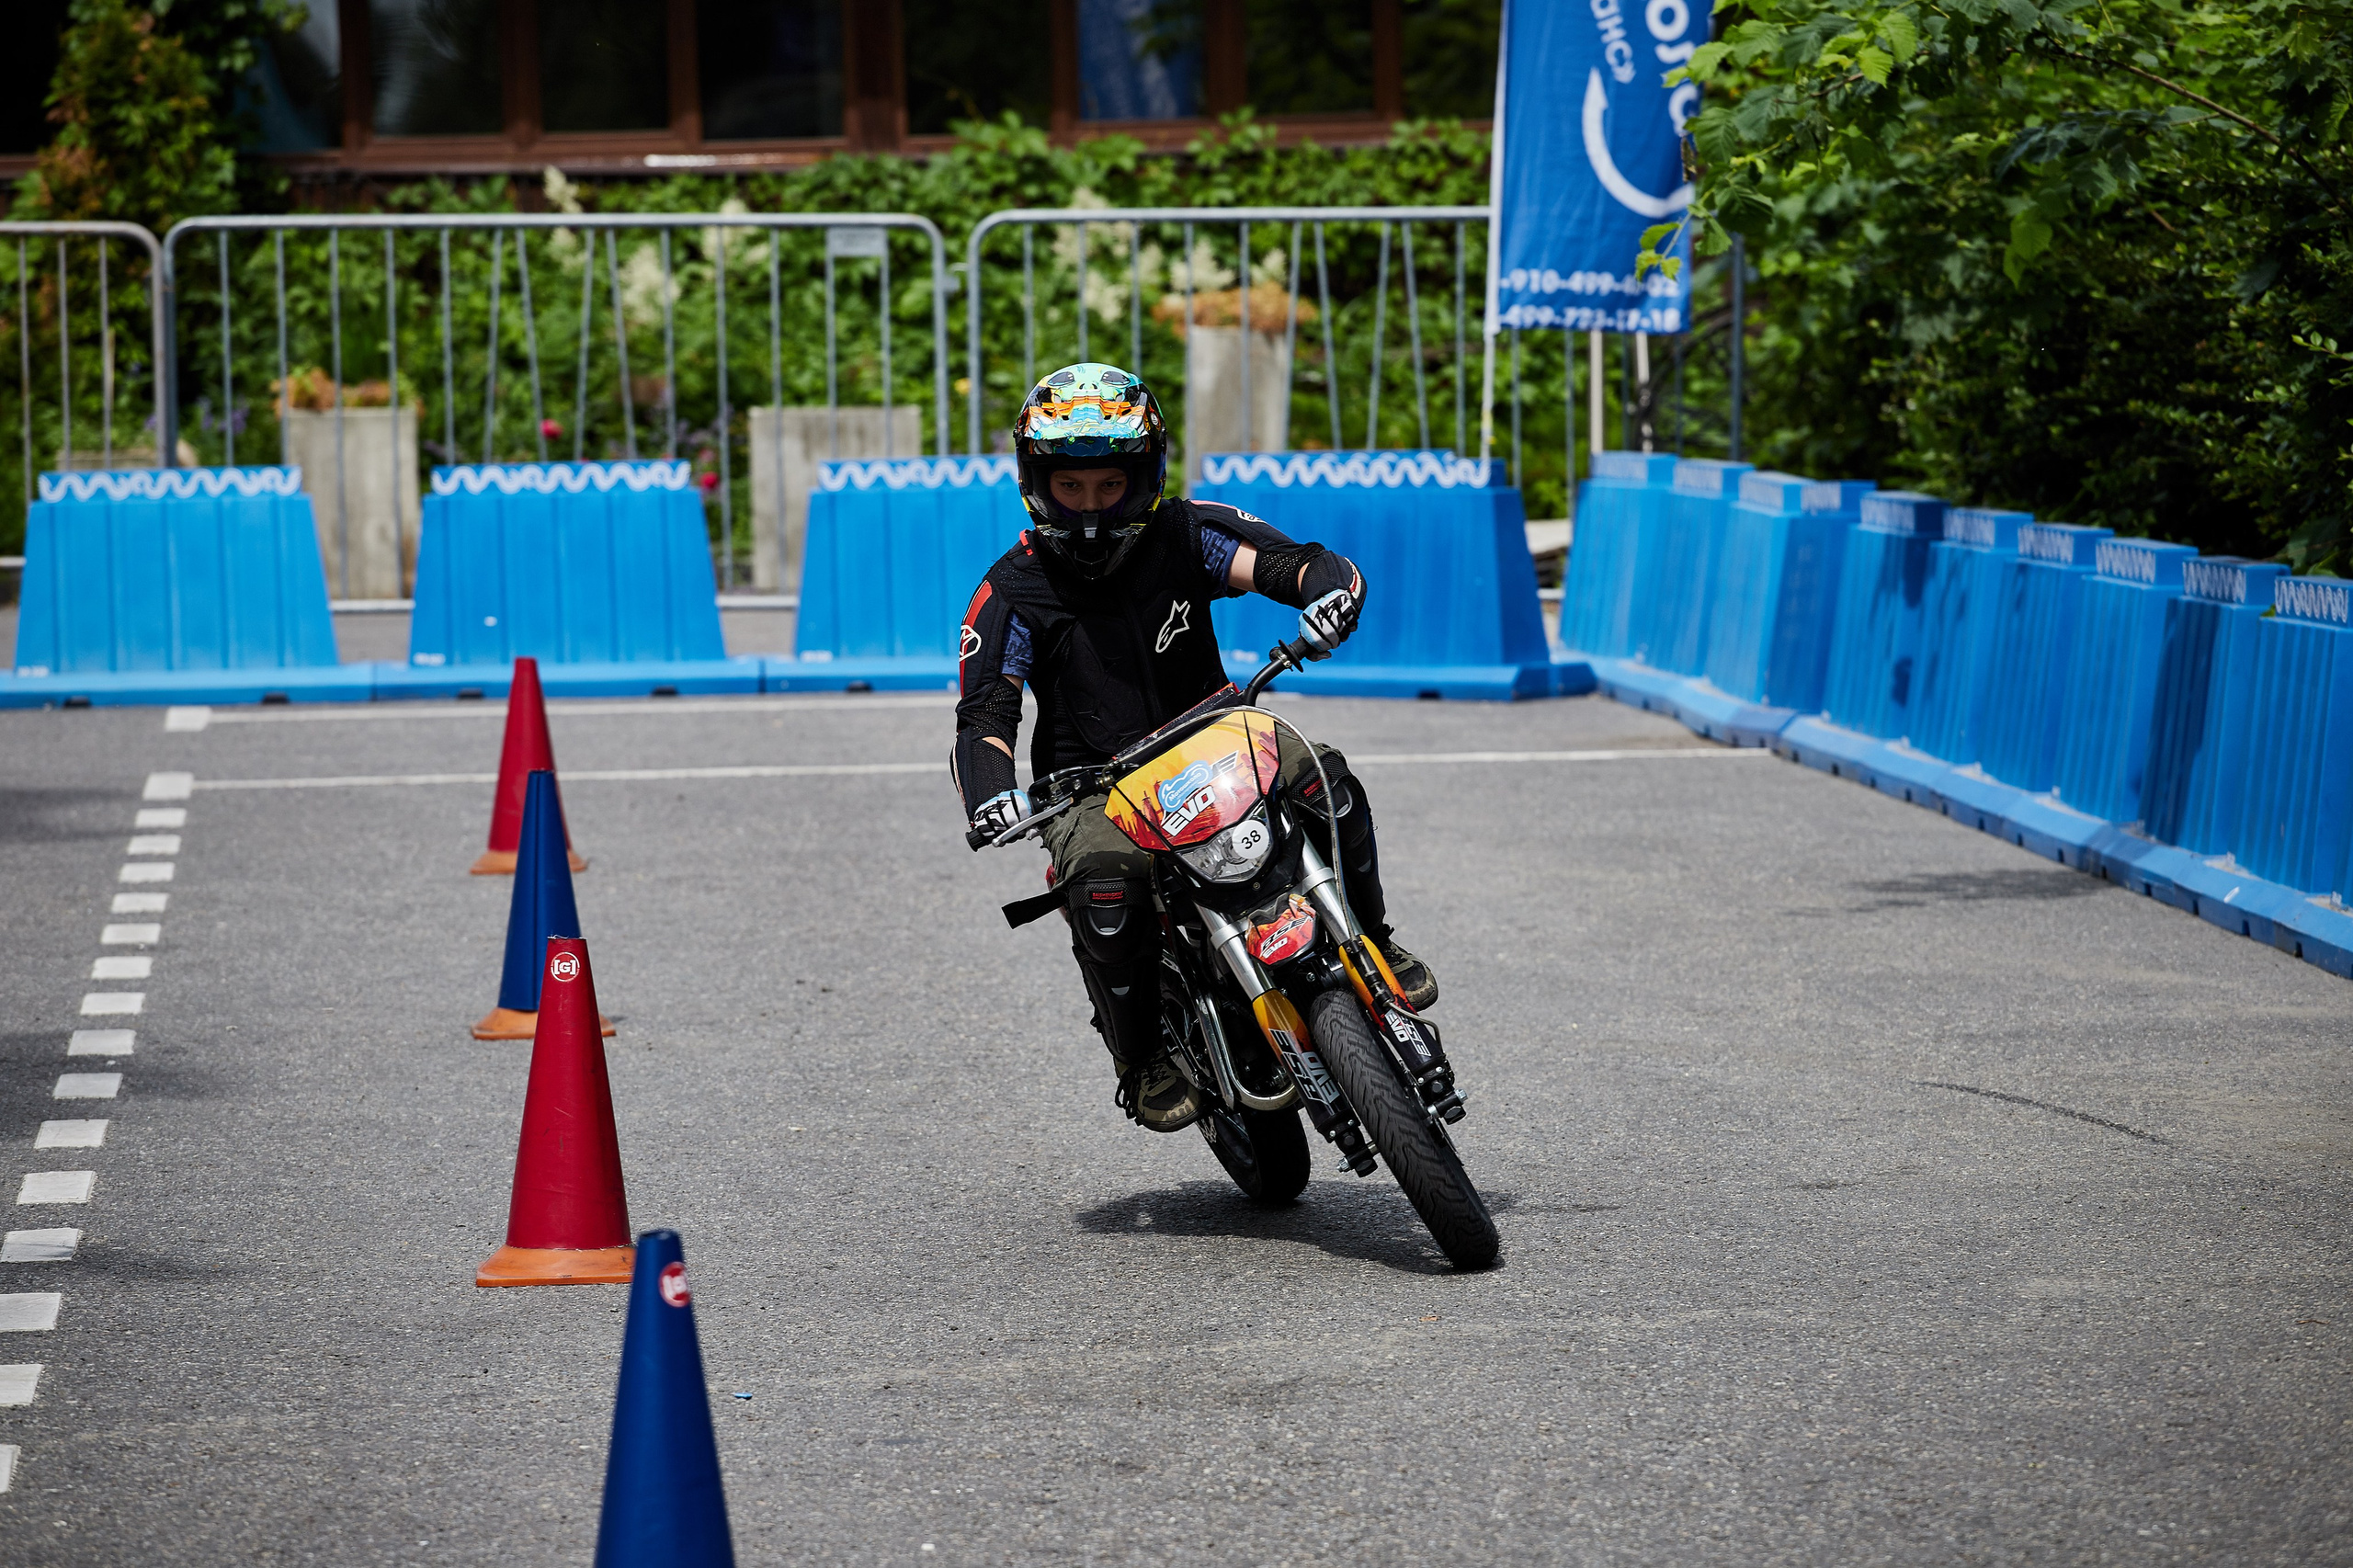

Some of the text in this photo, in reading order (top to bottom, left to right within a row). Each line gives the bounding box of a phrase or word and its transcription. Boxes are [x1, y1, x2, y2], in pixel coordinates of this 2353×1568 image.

[1161, 784, 1217, 837] EVO
[1241, 829, 1261, 850] 38
[1262, 937, 1289, 959] EVO
[1384, 1008, 1410, 1043] EVO
[1301, 1051, 1341, 1104] EVO
